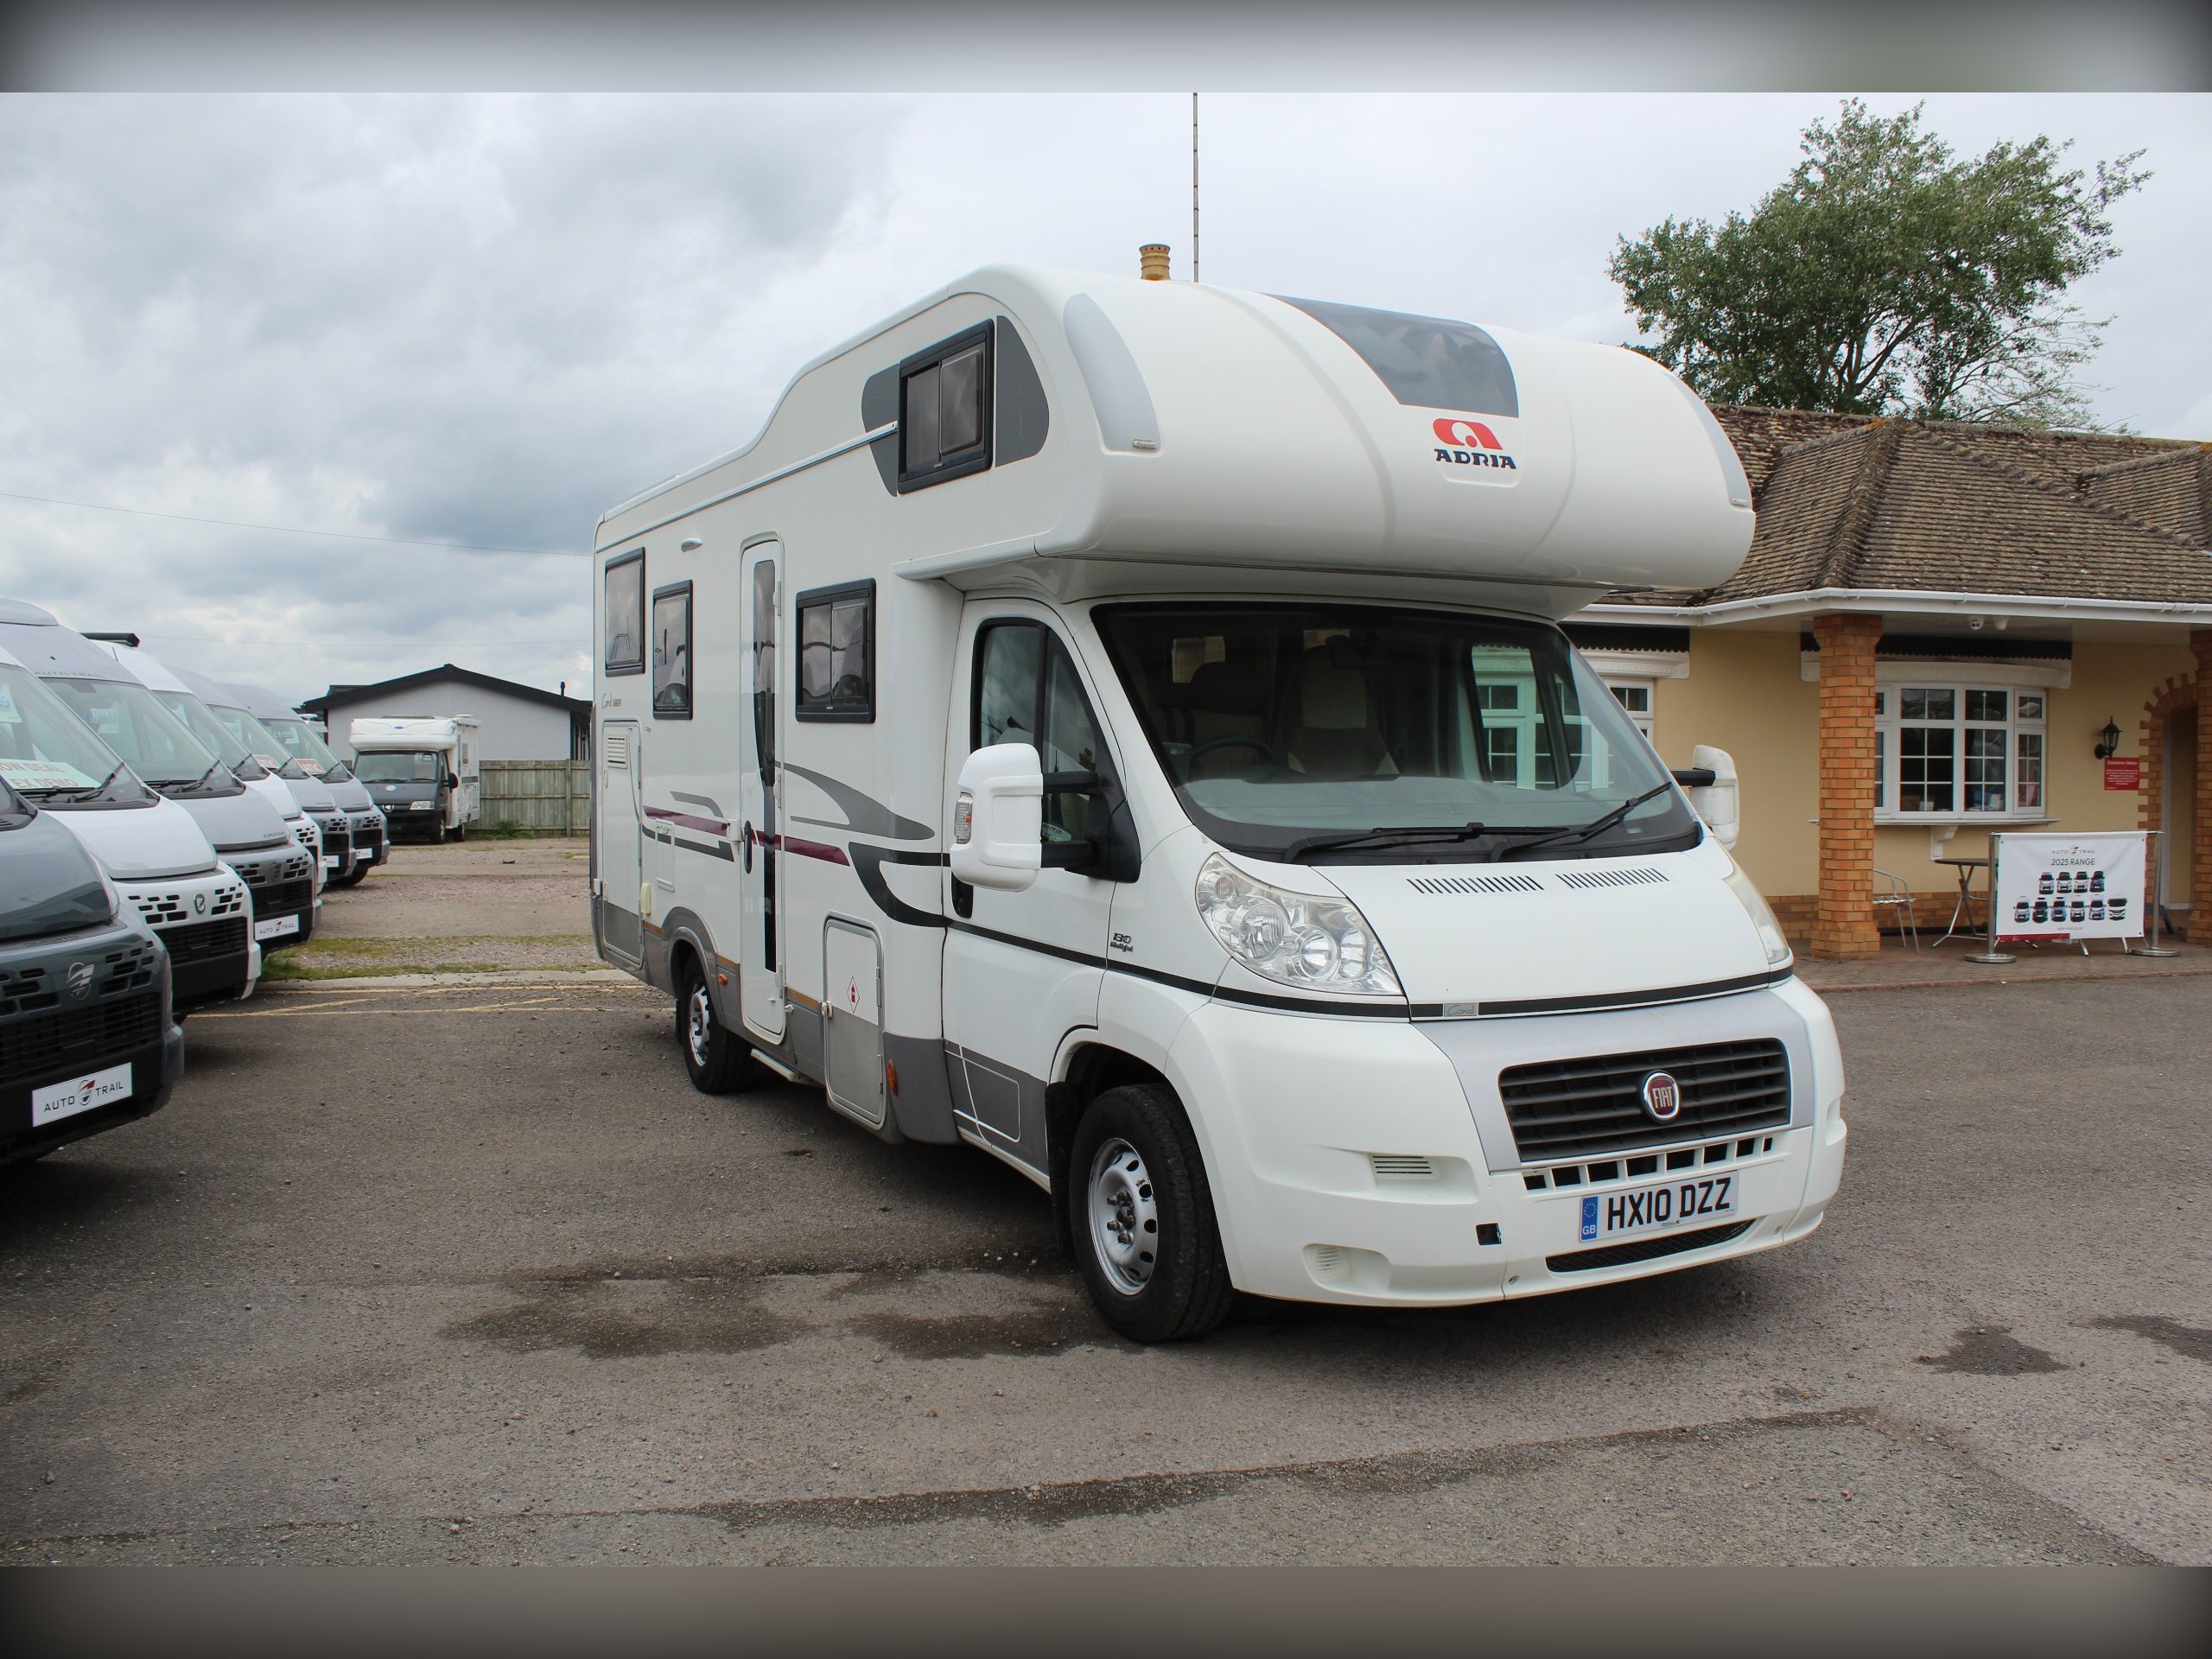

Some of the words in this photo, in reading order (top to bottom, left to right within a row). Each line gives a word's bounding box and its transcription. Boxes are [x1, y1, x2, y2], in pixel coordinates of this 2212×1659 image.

[1433, 448, 1517, 470] ADRIA
[1447, 1004, 1475, 1016] Coral
[43, 1096, 75, 1113] AUTO
[95, 1081, 124, 1096] TRAIL
[1652, 1086, 1673, 1109] FIAT
[1607, 1188, 1671, 1231] HX10
[1680, 1177, 1731, 1218] DZZ
[1582, 1224, 1597, 1236] GB
